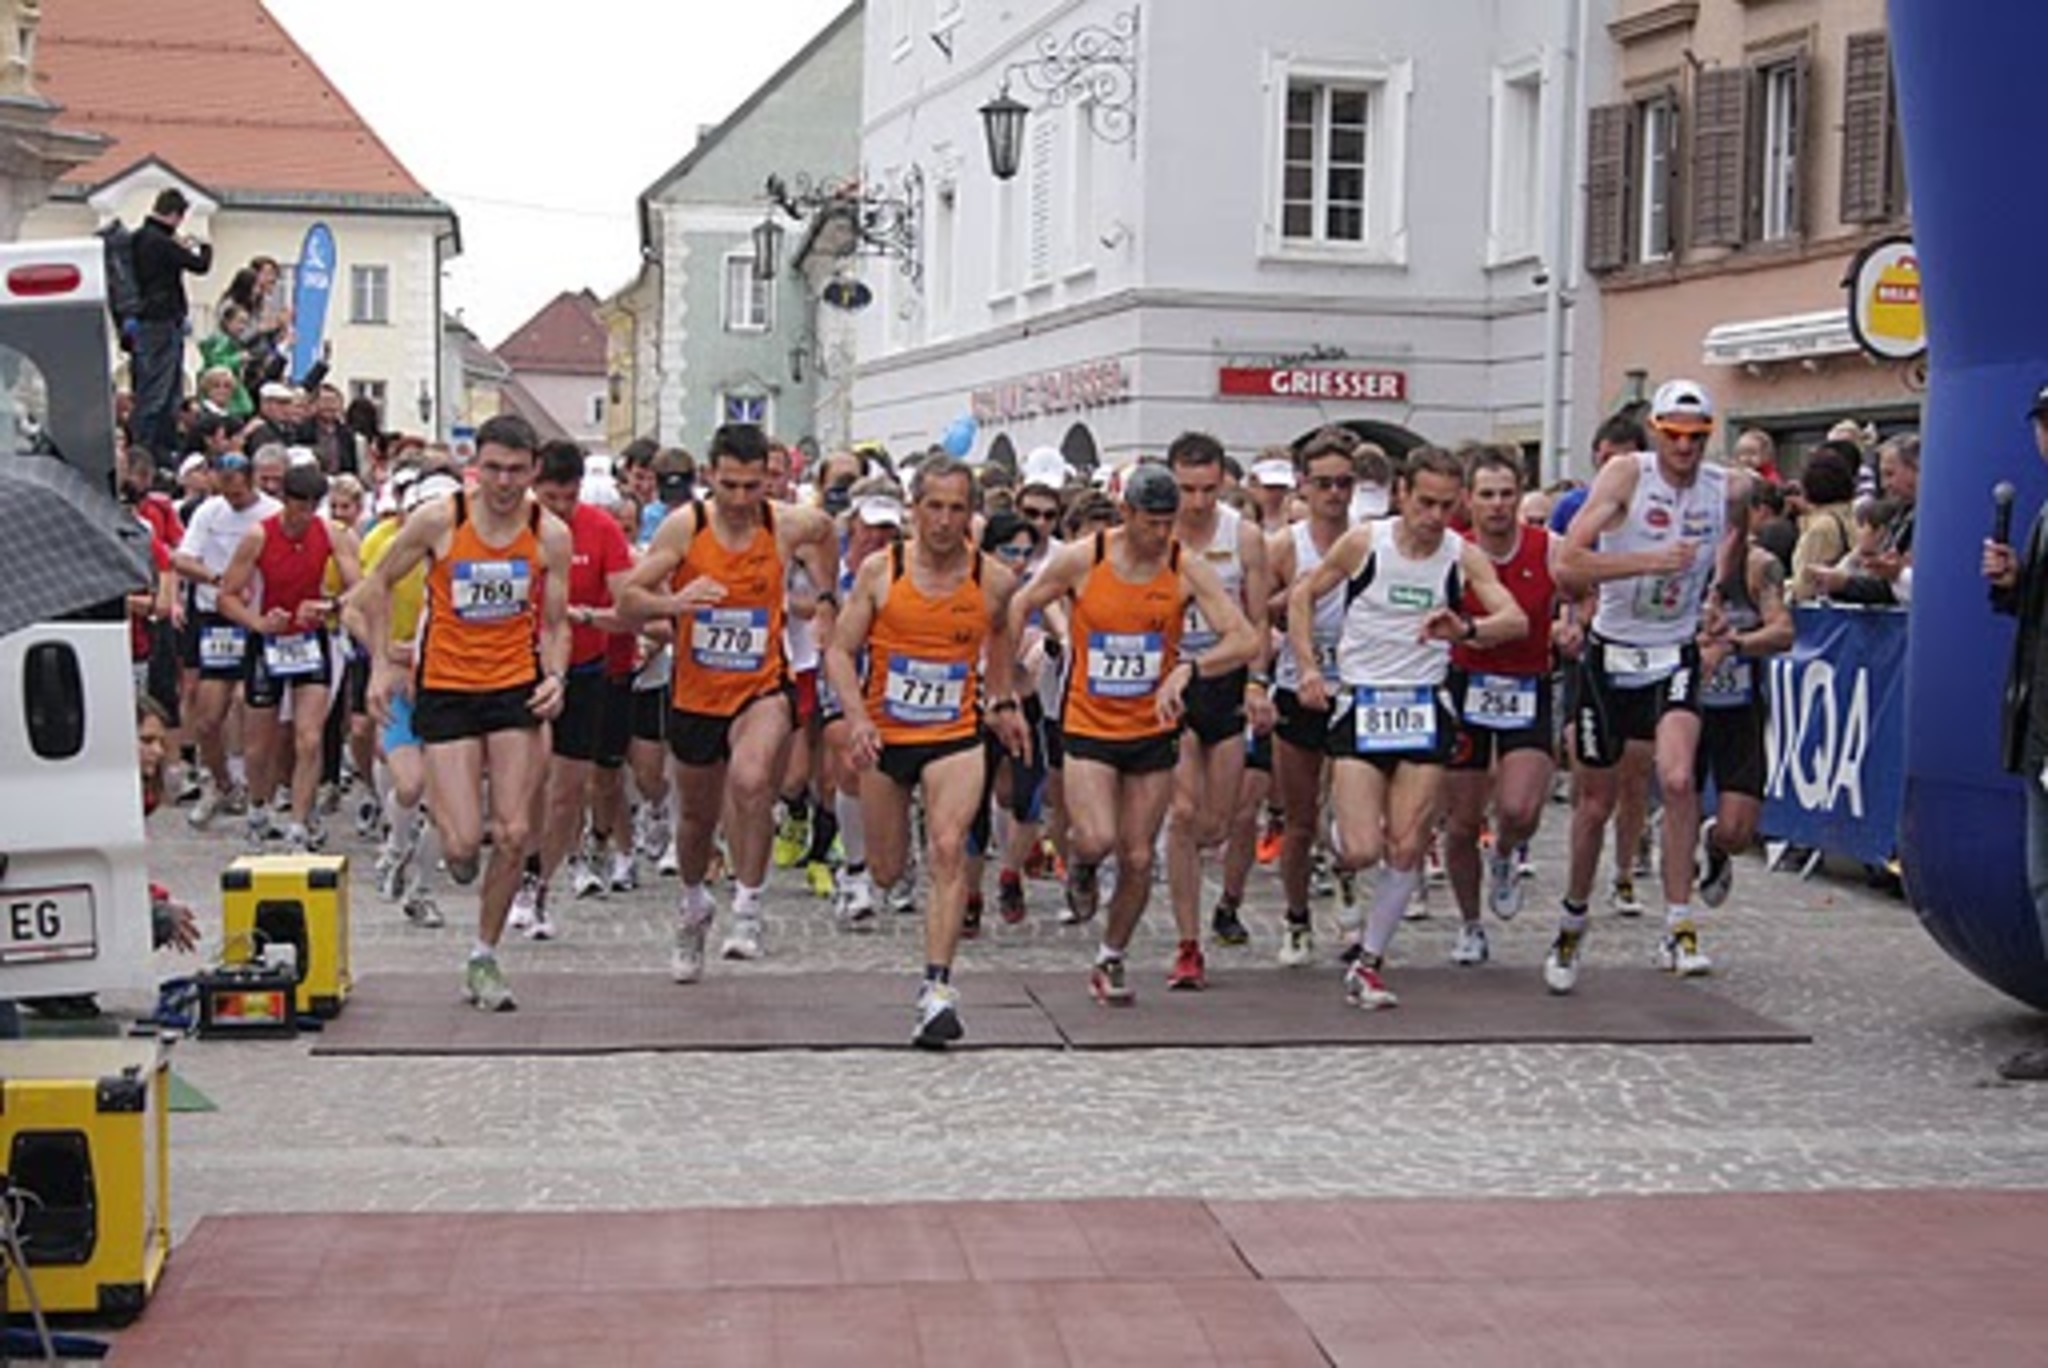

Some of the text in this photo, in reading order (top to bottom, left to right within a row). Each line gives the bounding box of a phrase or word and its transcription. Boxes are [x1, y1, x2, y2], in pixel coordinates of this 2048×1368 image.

[1270, 371, 1398, 398] GRIESSER
[470, 579, 513, 603] 769
[708, 626, 753, 653] 770
[1103, 654, 1145, 678] 773
[903, 679, 945, 704] 771
[1364, 707, 1425, 733] 810a
[11, 899, 61, 941] EG
